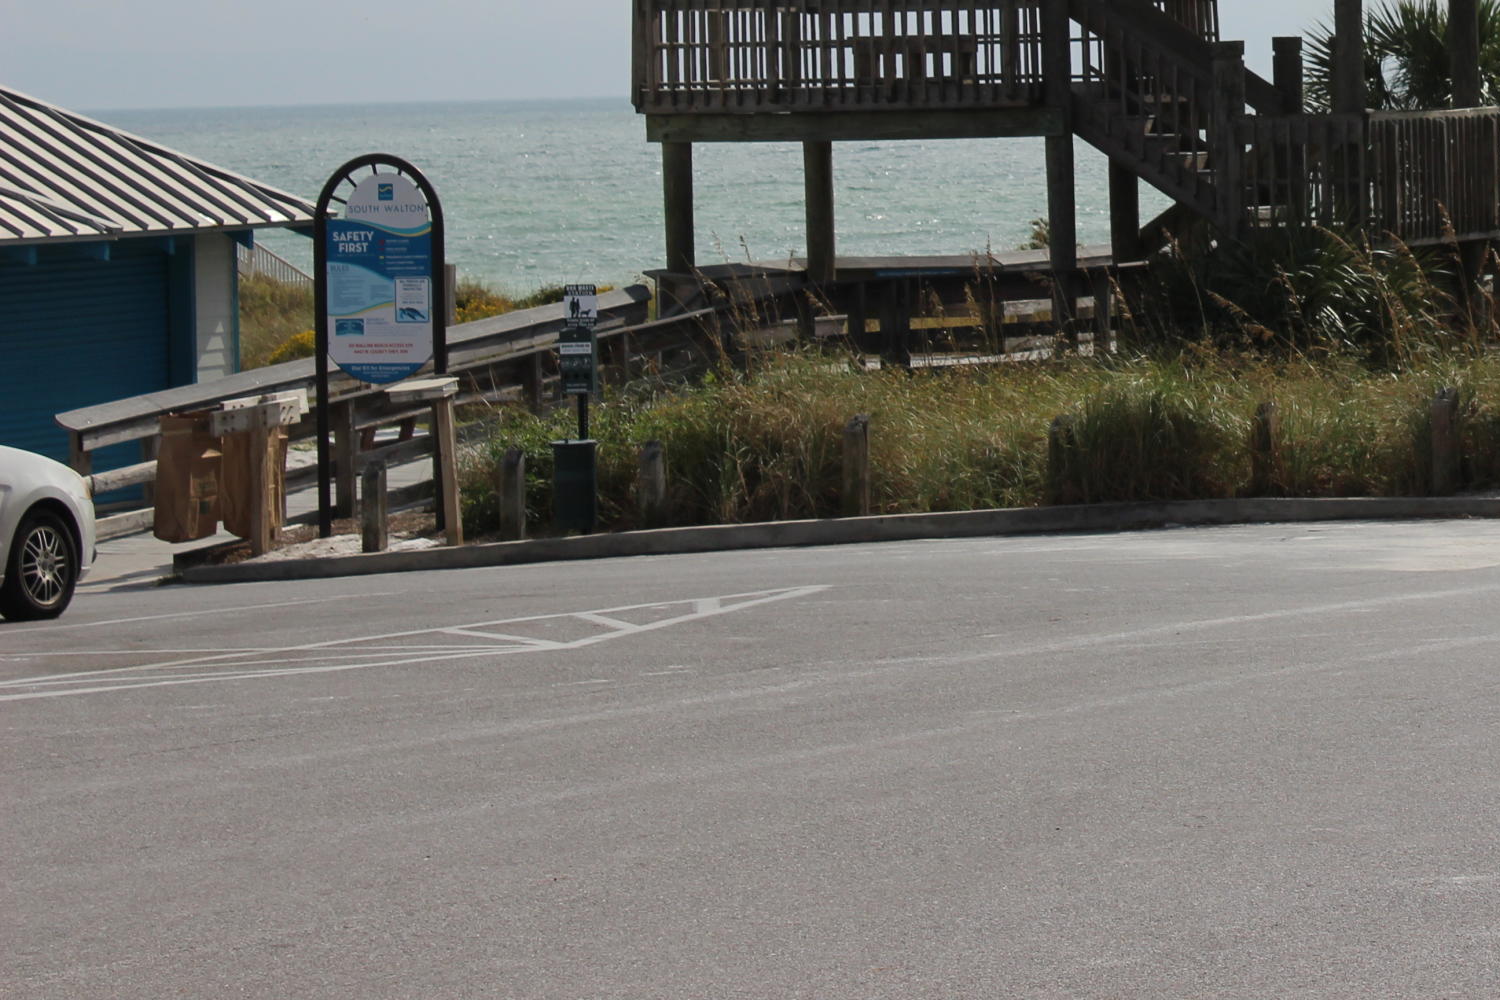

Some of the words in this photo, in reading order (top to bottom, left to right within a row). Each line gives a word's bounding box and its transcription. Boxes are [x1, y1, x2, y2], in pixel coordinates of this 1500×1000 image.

[348, 205, 380, 214] SOUTH
[384, 204, 424, 213] WALTON
[332, 231, 374, 241] SAFETY
[338, 243, 369, 253] FIRST
